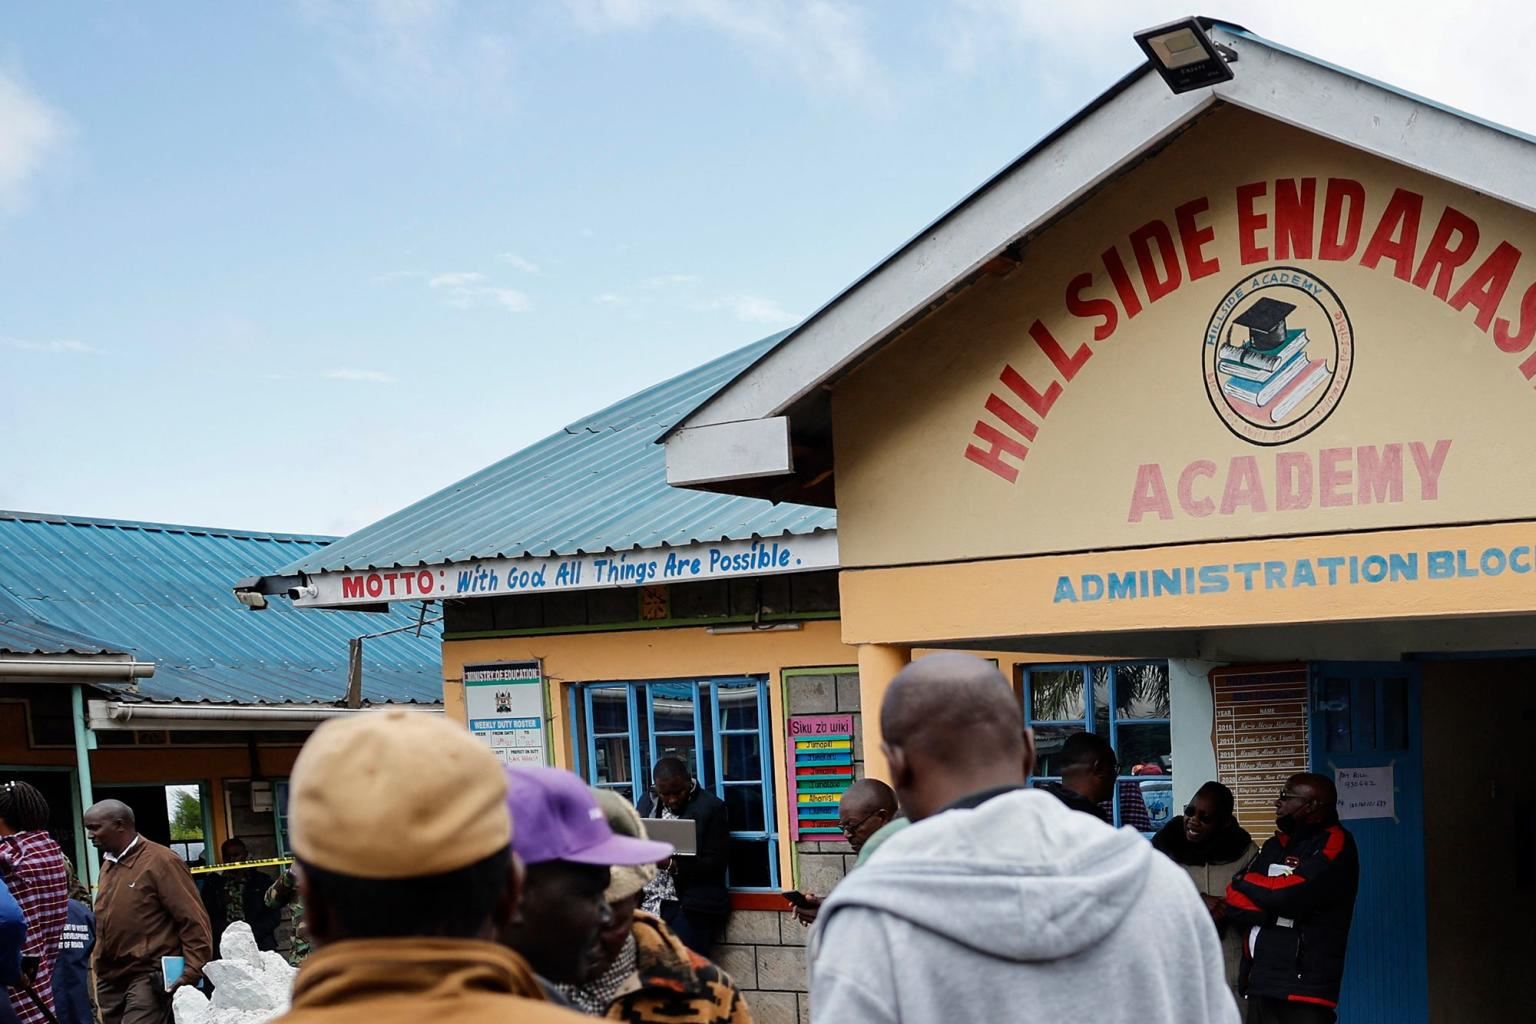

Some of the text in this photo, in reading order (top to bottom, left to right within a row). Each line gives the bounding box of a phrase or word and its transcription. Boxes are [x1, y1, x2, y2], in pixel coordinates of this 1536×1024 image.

[1206, 272, 1323, 347] HILLSIDE ACADEMY
[964, 196, 1220, 484] HILLSIDE
[1127, 439, 1453, 522] ACADEMY
[342, 540, 802, 598] MOTTO: With God All Things Are Possible.
[1053, 552, 1419, 603] ADMINISTRATION
[495, 670, 504, 681] OF
[504, 668, 537, 681] EDUCATION
[474, 719, 536, 729] WEEKLY DUTY ROSTER
[792, 720, 812, 734] Siku
[830, 720, 849, 733] wiki
